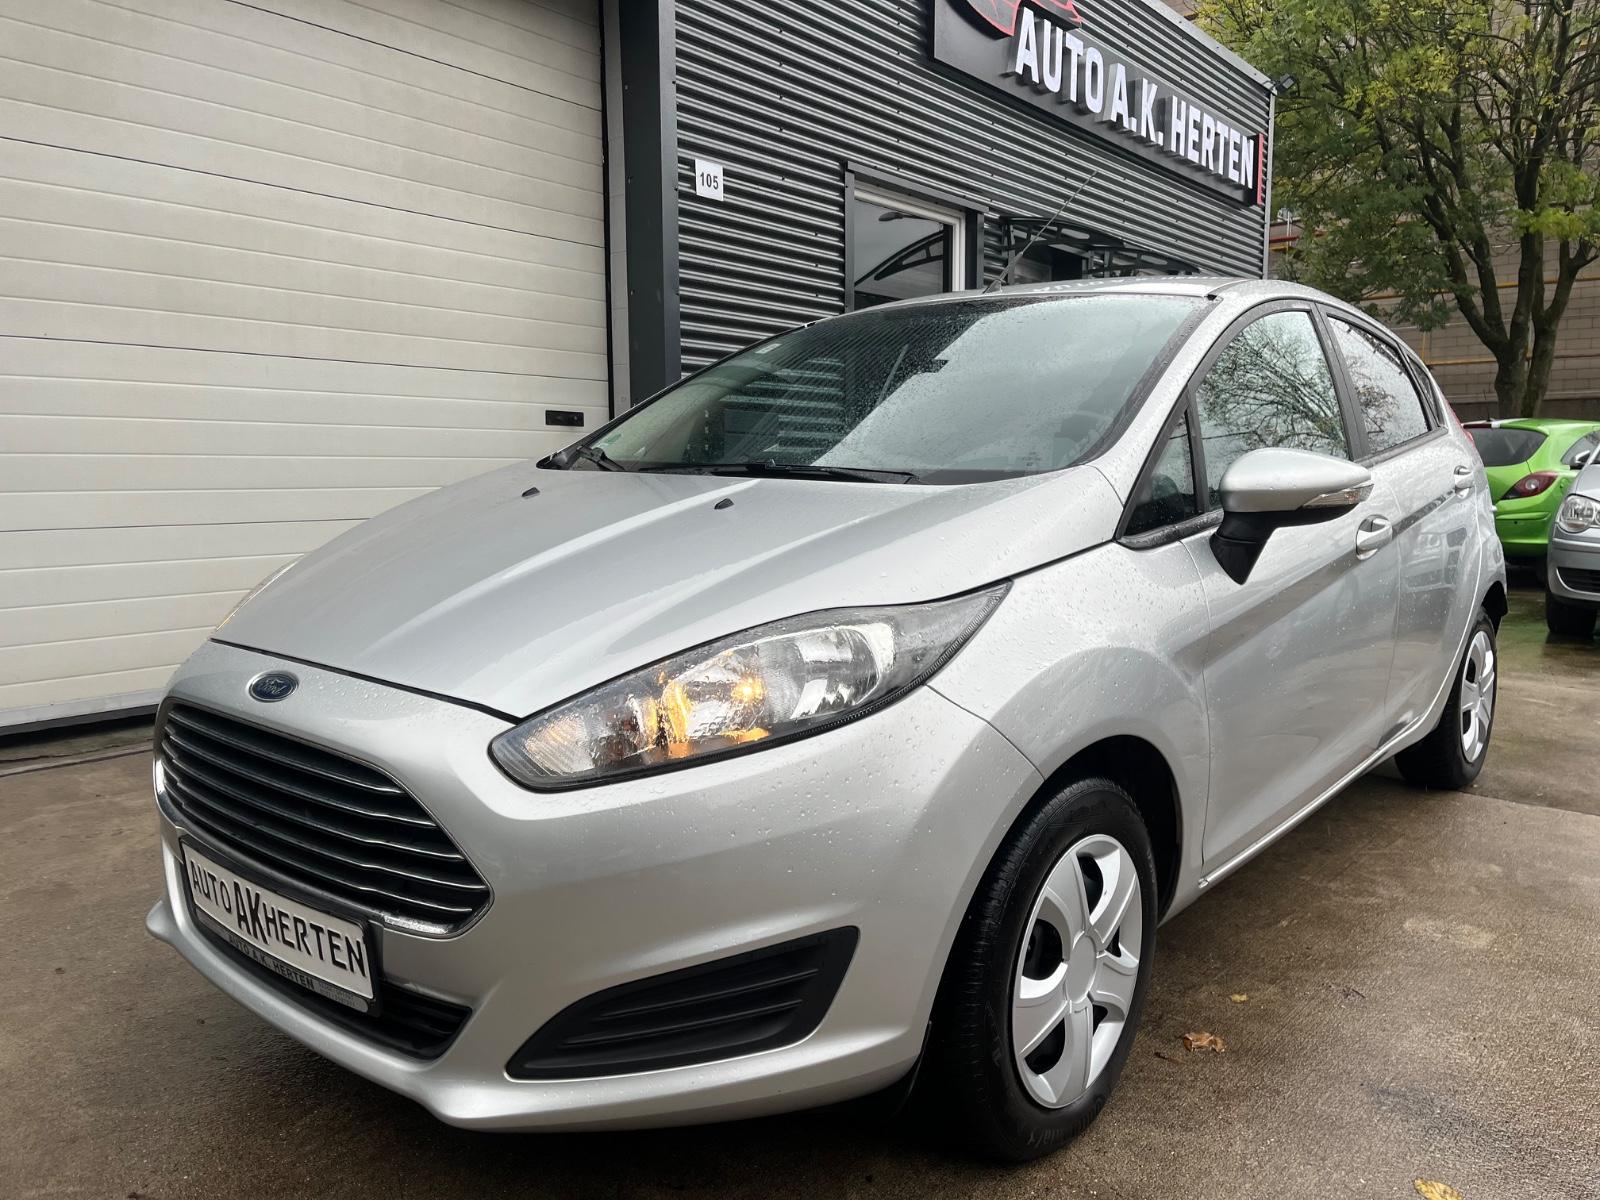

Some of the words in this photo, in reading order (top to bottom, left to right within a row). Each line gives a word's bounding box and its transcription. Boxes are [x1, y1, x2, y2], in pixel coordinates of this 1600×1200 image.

[1015, 6, 1104, 114] AUTO
[1171, 95, 1255, 189] HERTEN
[700, 172, 719, 190] 105
[272, 961, 315, 990] HERTEN
